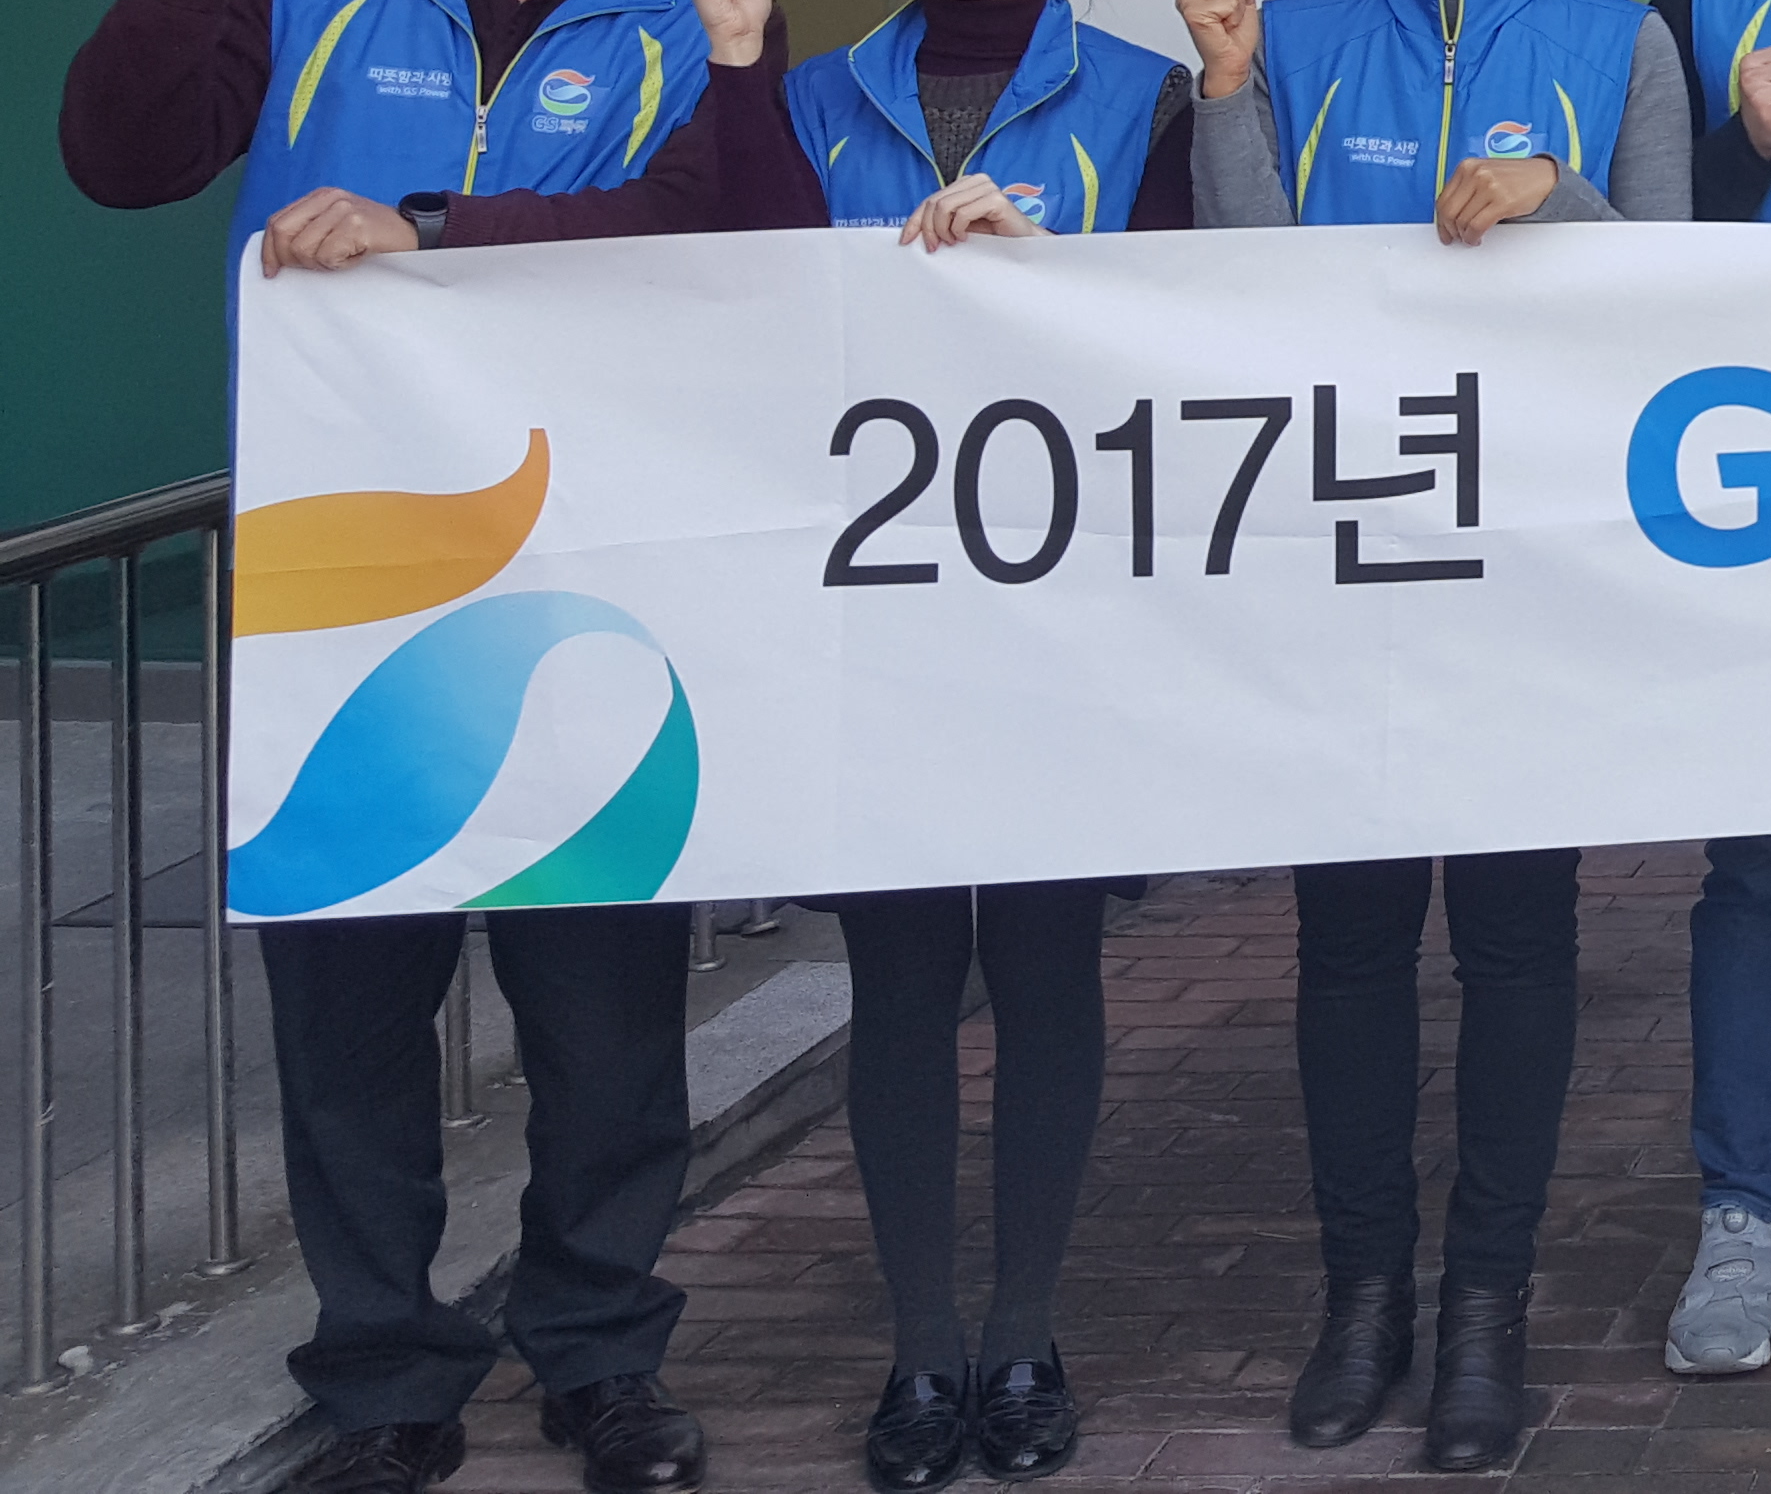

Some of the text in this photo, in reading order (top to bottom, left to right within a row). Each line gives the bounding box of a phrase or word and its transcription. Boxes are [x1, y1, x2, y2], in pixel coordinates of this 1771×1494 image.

[369, 67, 425, 84] 따뜻함과
[1343, 137, 1419, 155] 따뜻함과 사랑
[822, 371, 1485, 587] 2017년
